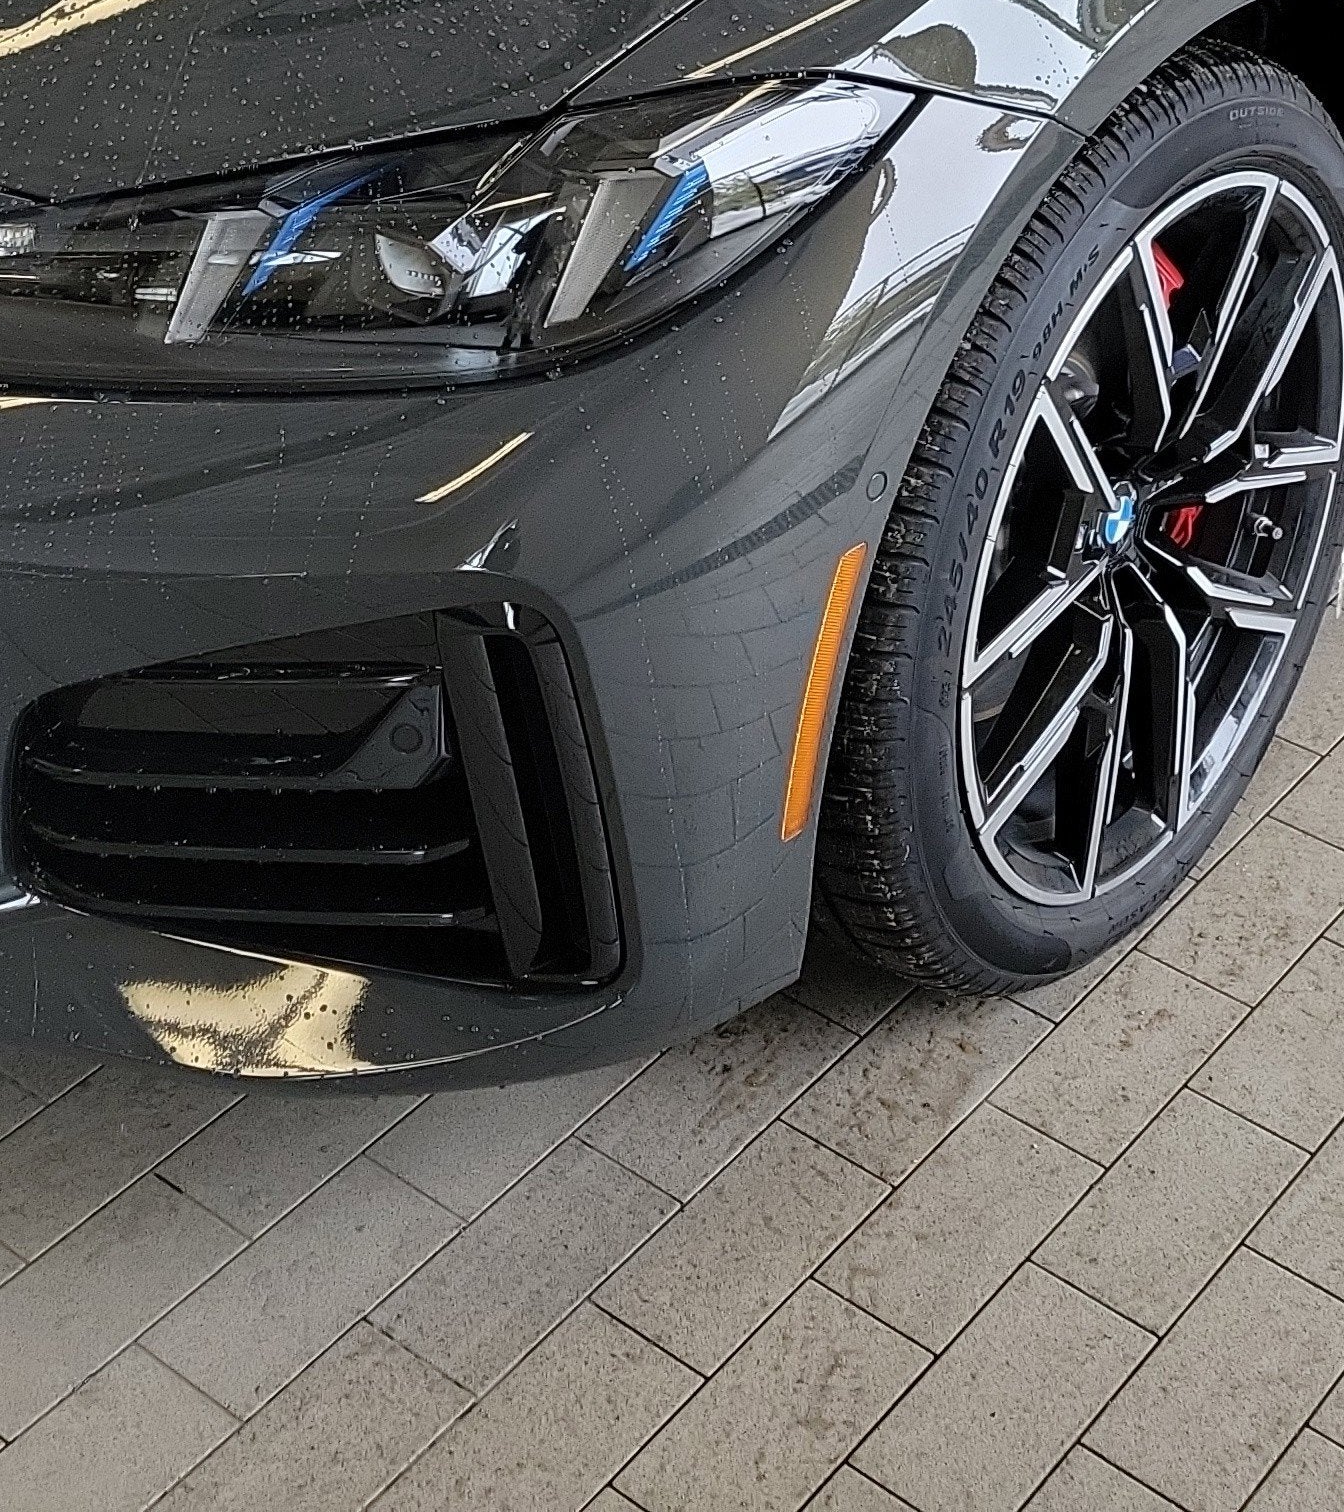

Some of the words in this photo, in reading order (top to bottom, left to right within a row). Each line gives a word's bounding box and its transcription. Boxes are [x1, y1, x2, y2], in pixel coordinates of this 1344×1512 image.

[1229, 106, 1285, 121] OUTSIDE
[937, 467, 989, 658] 245/40
[988, 369, 1026, 459] R19
[1032, 301, 1064, 361] 98H
